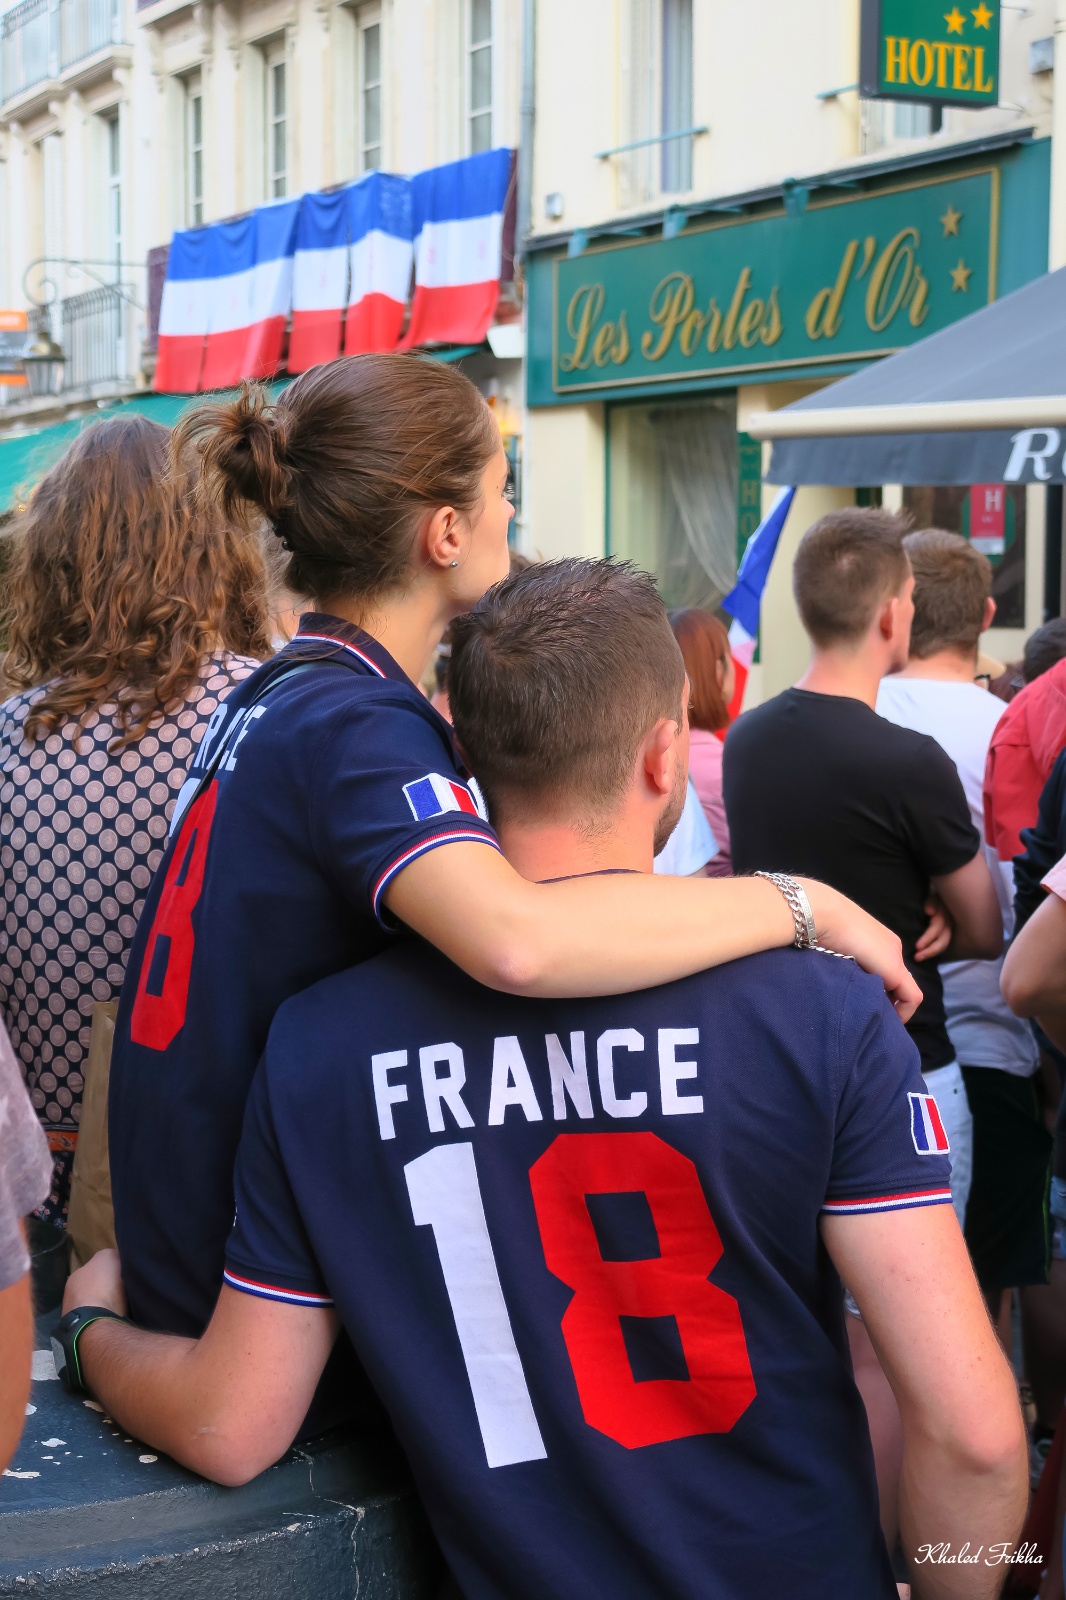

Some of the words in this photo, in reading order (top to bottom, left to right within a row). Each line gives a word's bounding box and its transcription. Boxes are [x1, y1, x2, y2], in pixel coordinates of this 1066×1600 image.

[885, 36, 993, 93] HOTEL
[560, 284, 629, 372] Les
[642, 267, 783, 361] Portes
[805, 227, 929, 341] d'Or
[1003, 427, 1066, 481] R
[371, 1027, 704, 1140] FRANCE
[403, 1131, 757, 1468] 18
